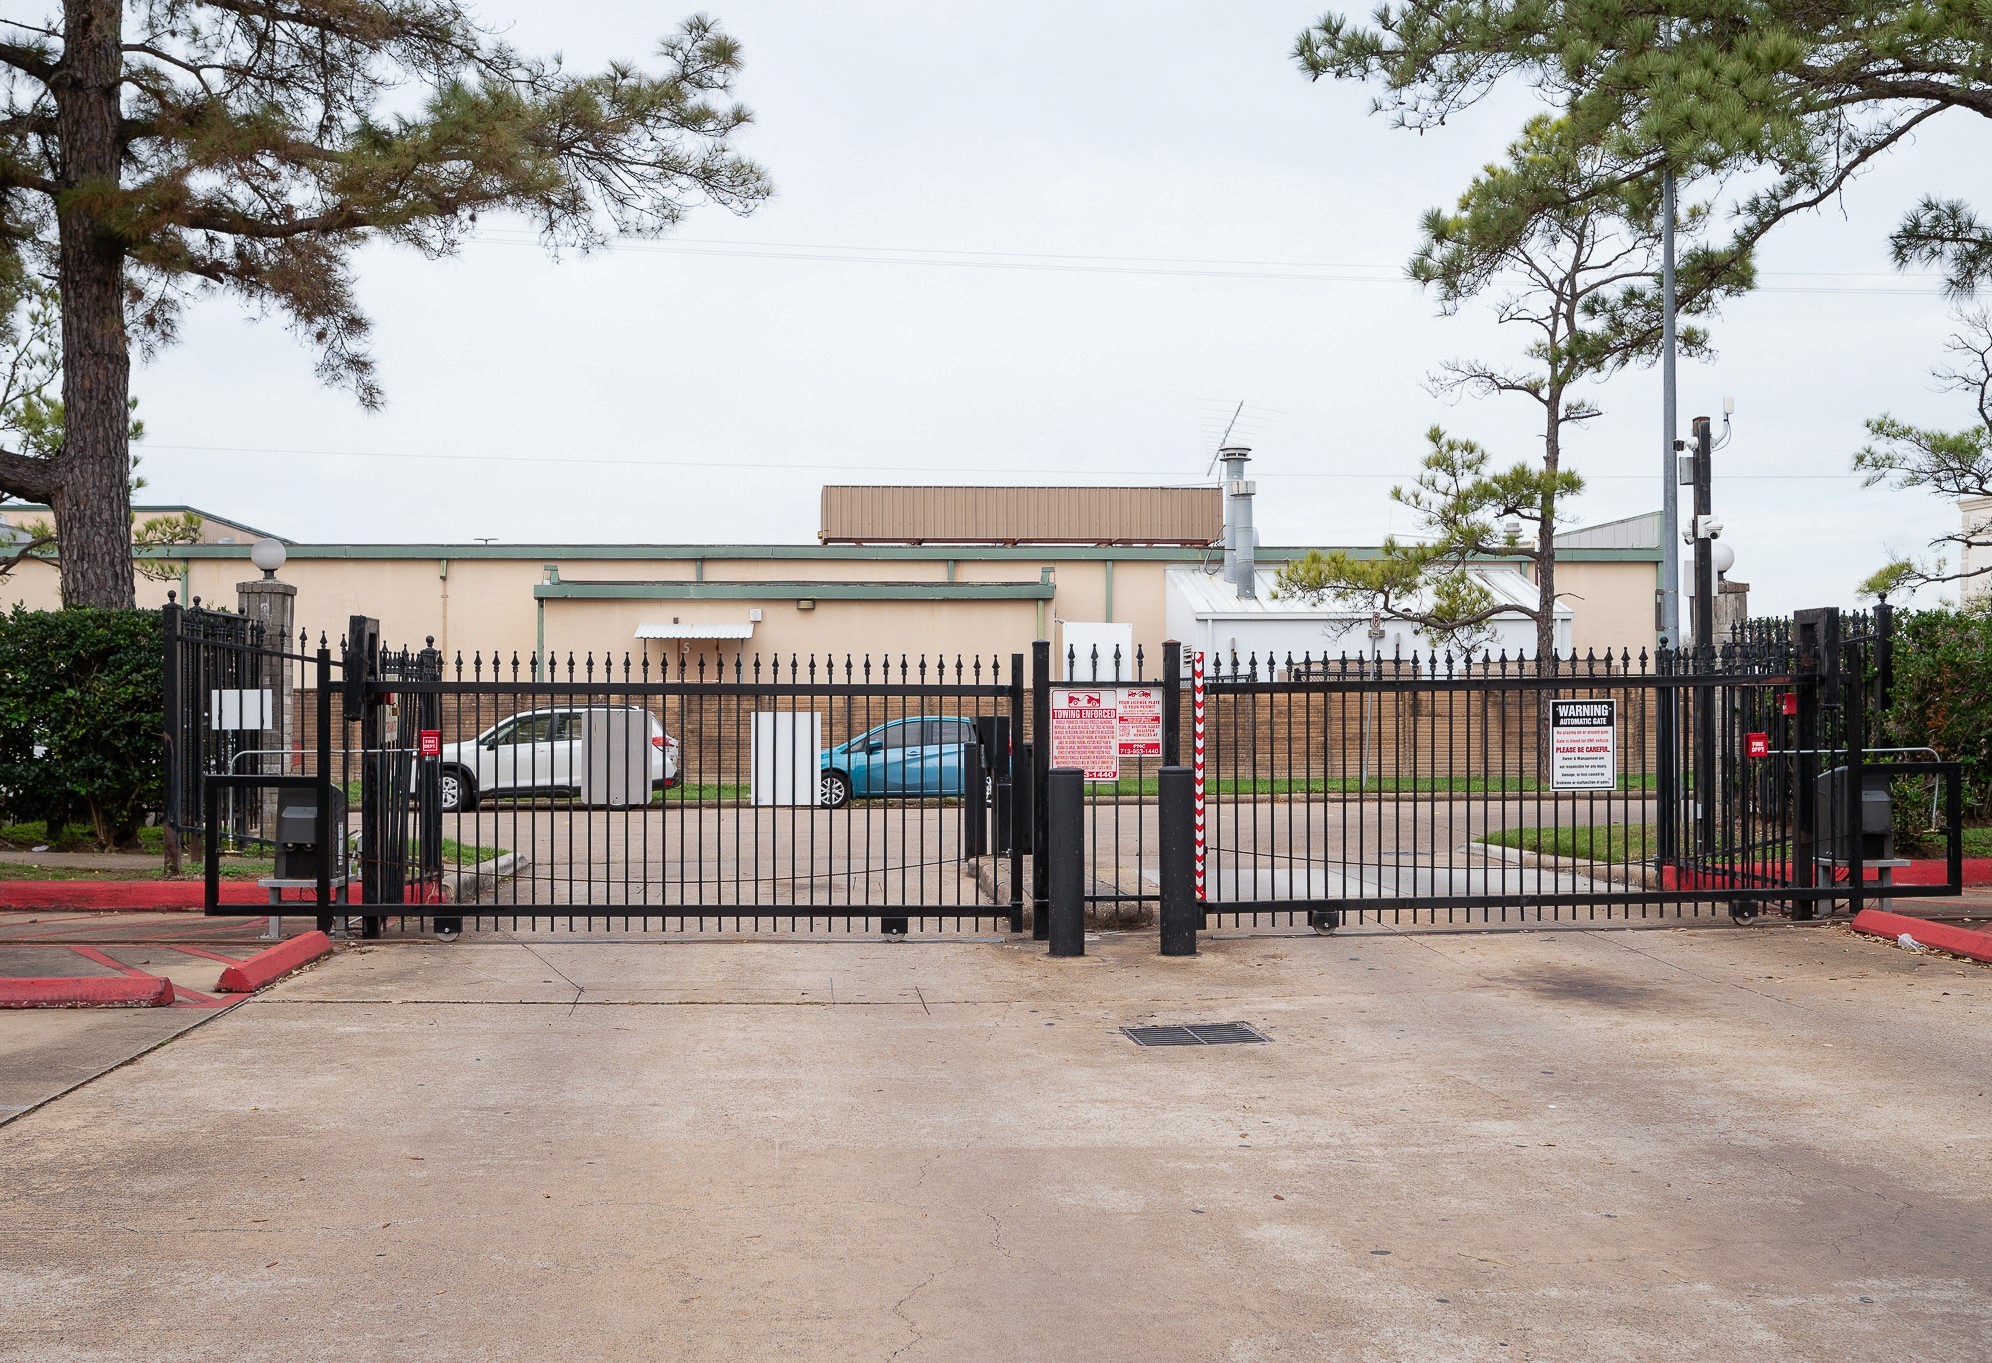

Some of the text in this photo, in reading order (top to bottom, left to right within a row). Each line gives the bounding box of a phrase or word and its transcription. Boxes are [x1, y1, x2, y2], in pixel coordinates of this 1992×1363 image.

[683, 642, 690, 654] 5
[1054, 709, 1115, 719] TOWING ENFORCED
[1558, 704, 1608, 717] WARNING
[1593, 717, 1607, 725] GATE
